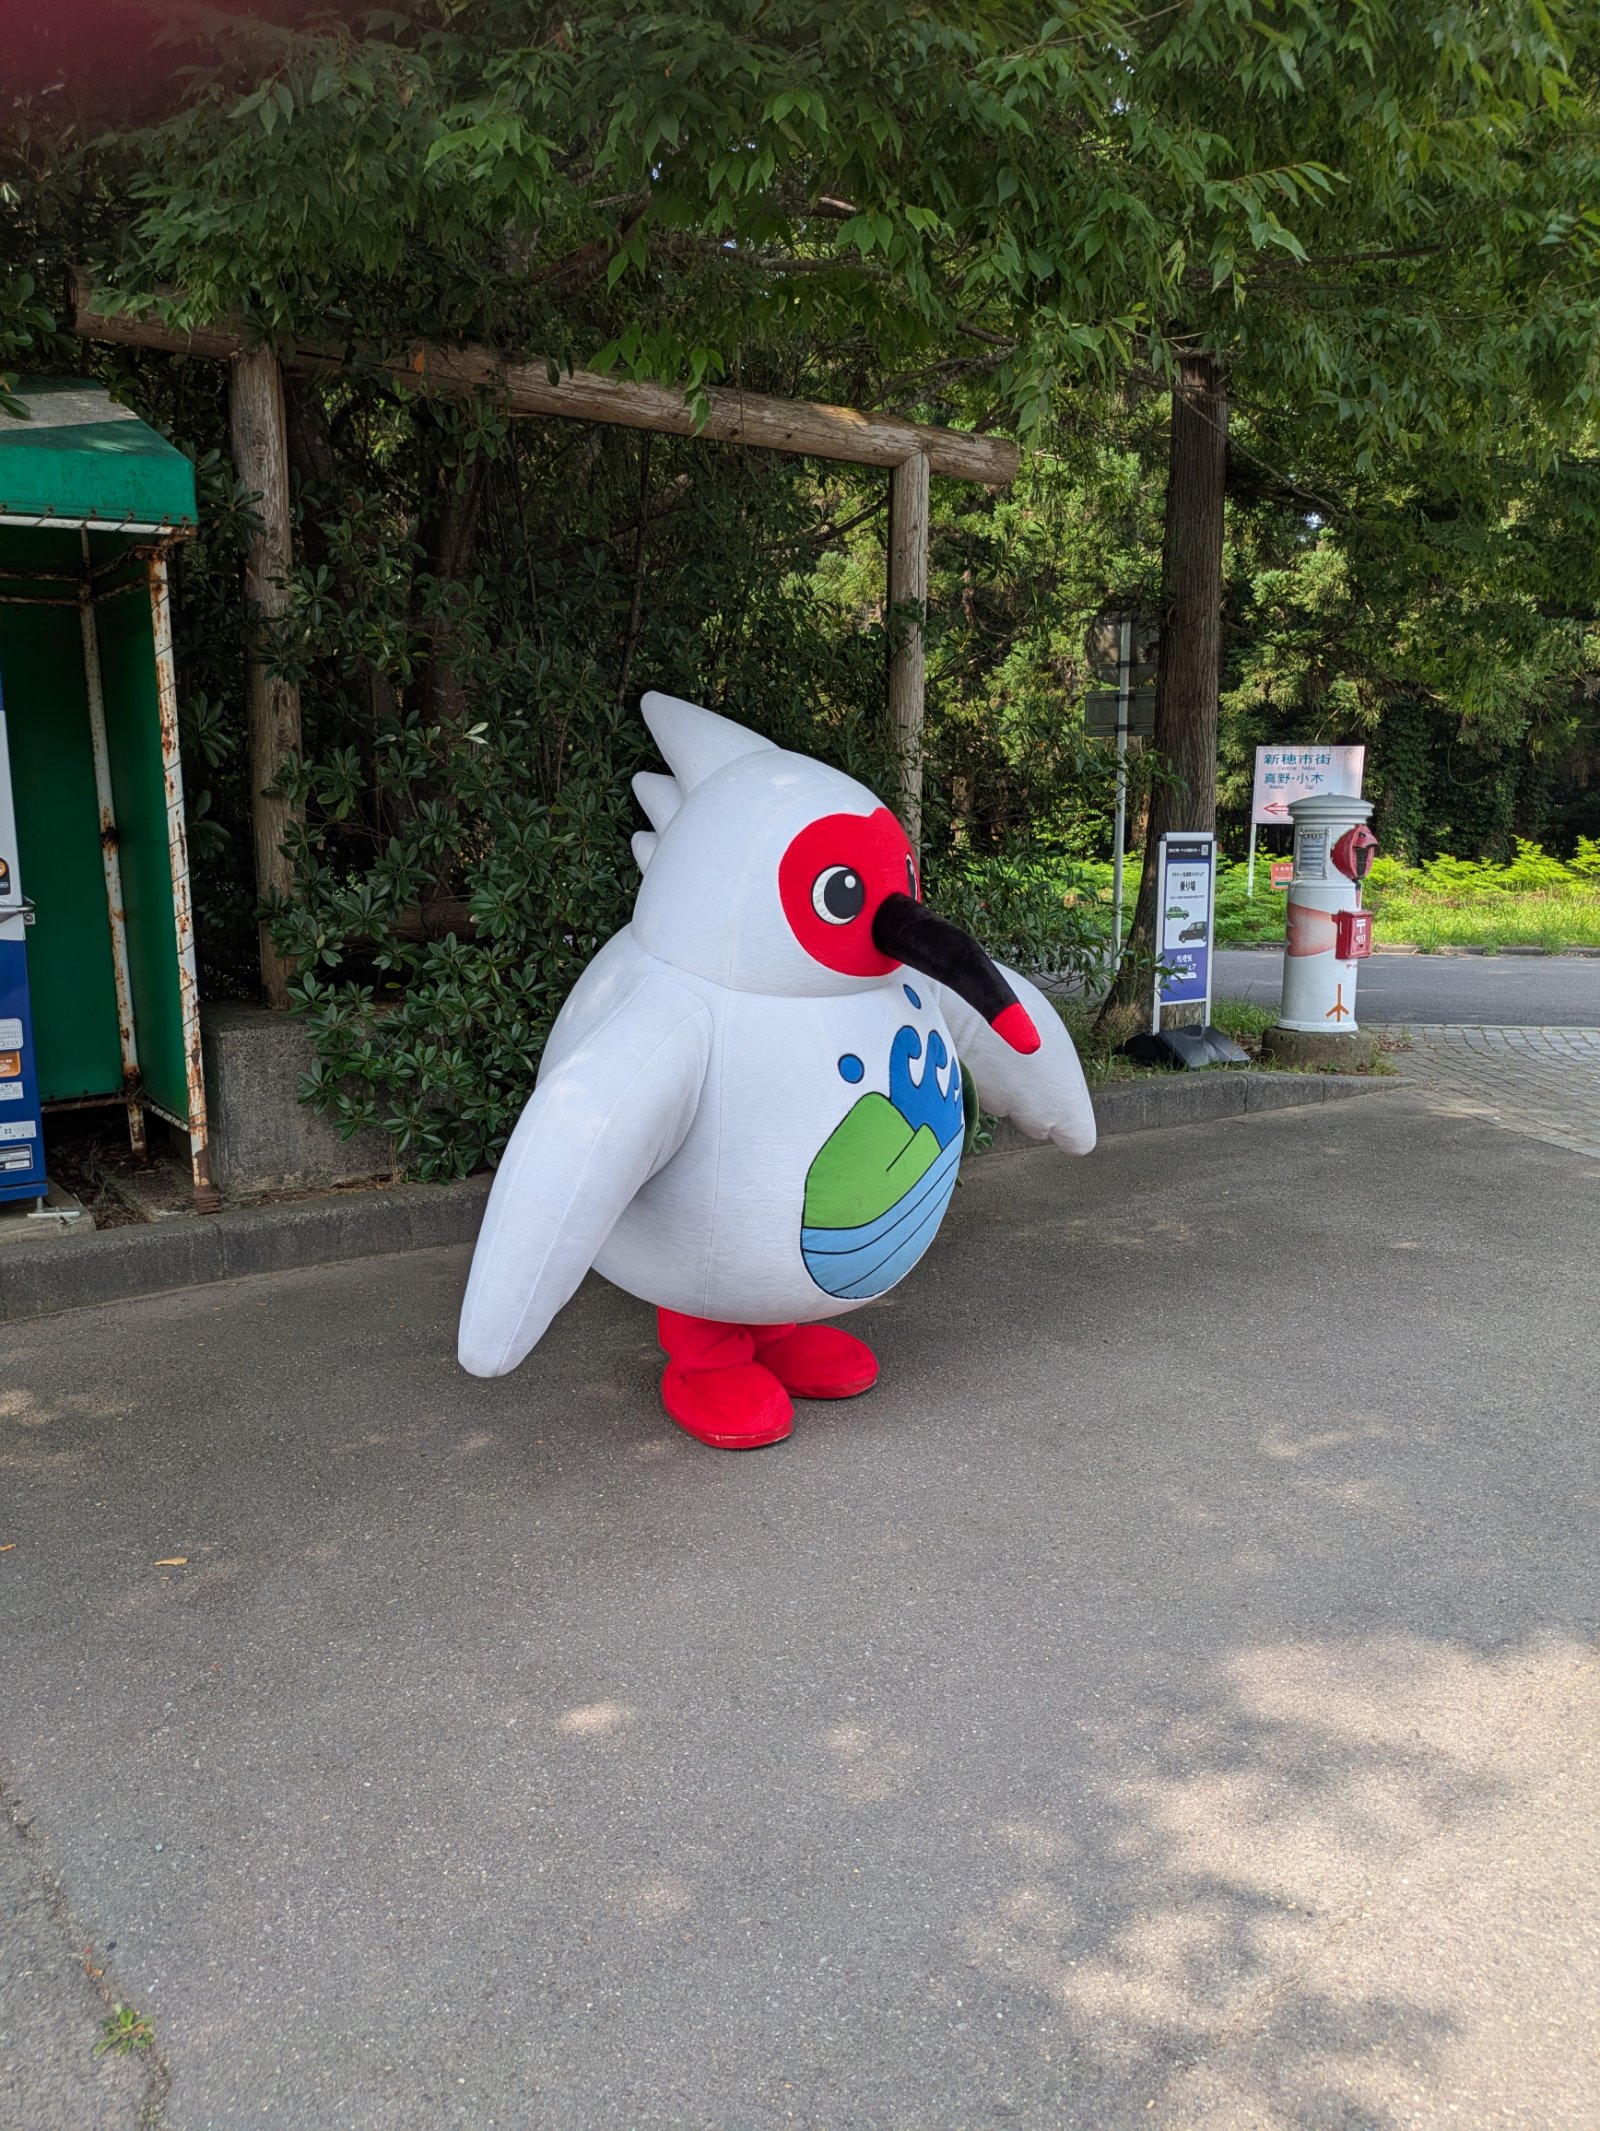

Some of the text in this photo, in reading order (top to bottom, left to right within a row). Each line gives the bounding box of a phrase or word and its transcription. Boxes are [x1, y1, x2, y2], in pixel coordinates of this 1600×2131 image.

[1264, 754, 1331, 765] 新穂市街
[1180, 880, 1196, 891] 乗り場
